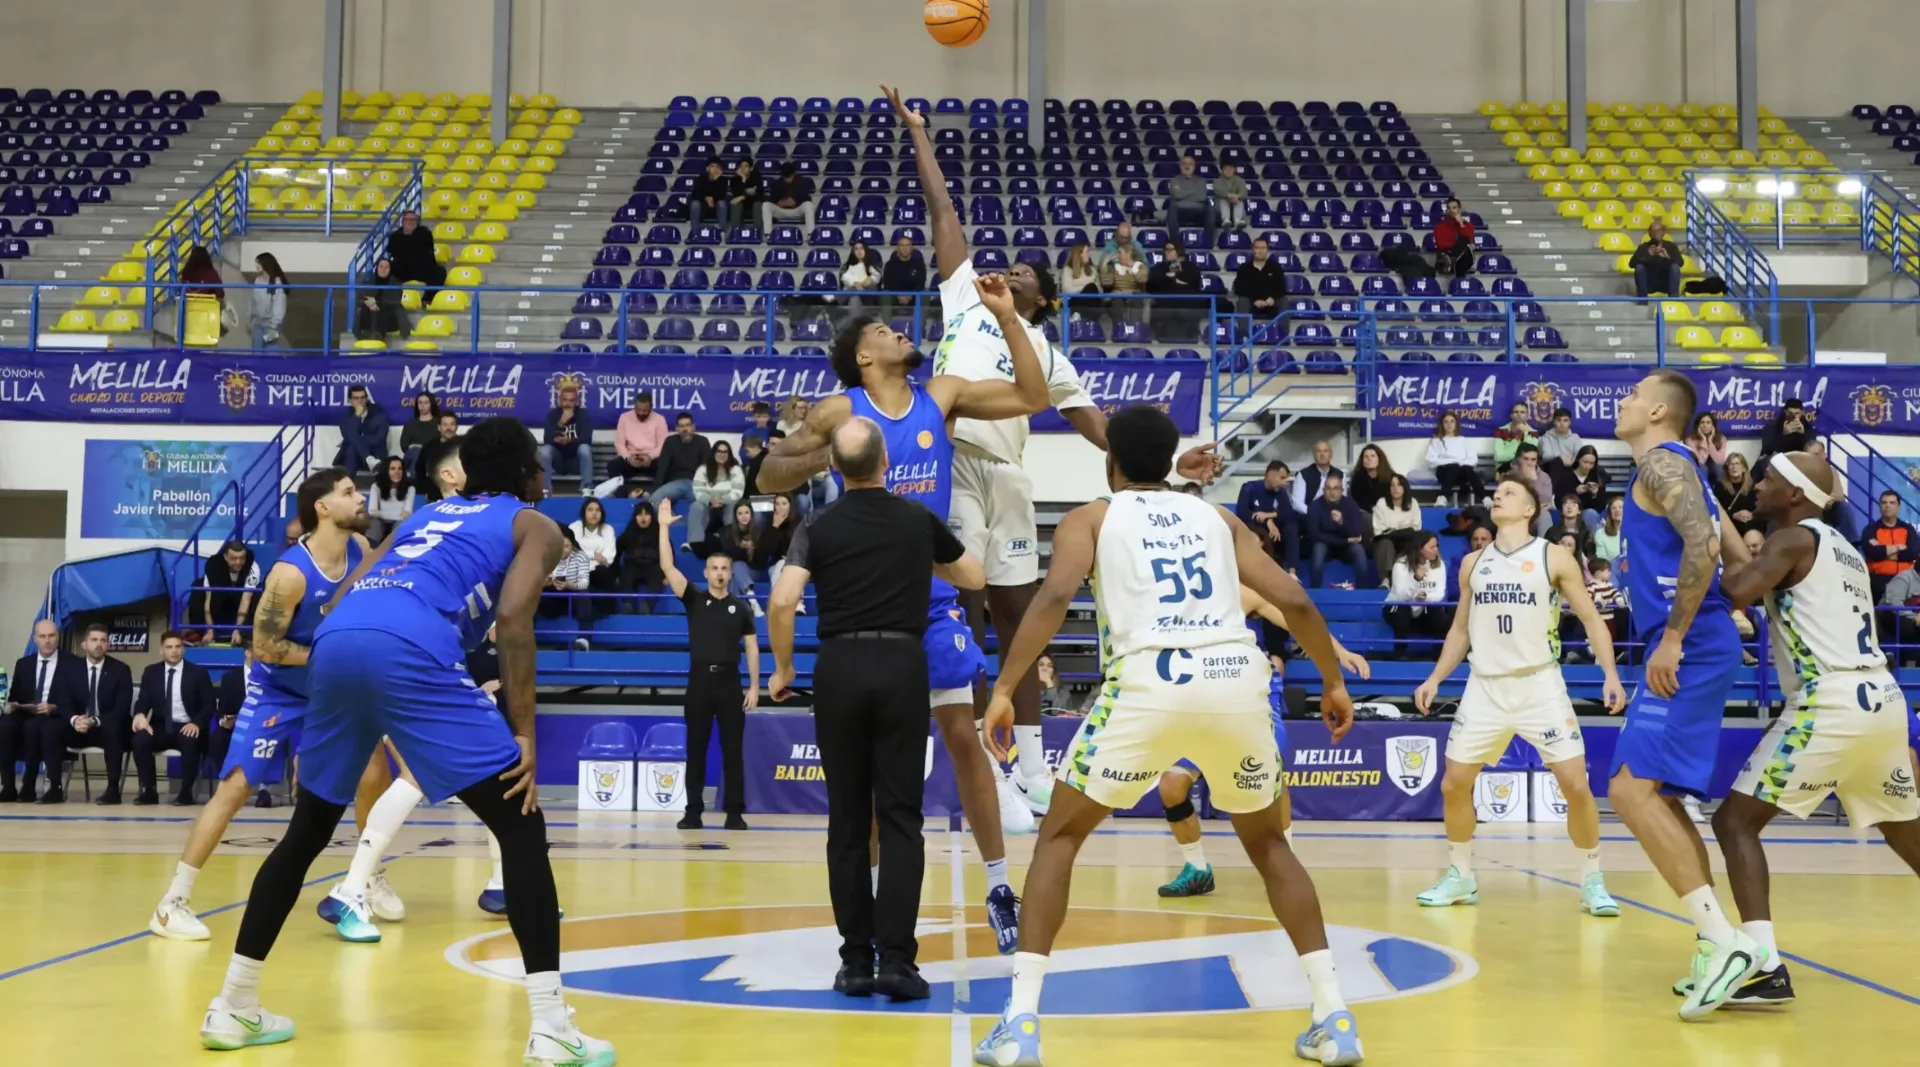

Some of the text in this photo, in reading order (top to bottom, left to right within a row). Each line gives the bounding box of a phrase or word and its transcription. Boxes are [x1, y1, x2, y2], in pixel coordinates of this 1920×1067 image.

[0, 367, 45, 378] ÓNOMA
[69, 358, 191, 390] MELILLA
[265, 372, 376, 384] CIUDAD AUTÓNOMA
[401, 364, 523, 395] MELILLA
[596, 375, 706, 386] CIUDAD AUTÓNOMA
[1378, 374, 1496, 407] MELILLA
[1571, 386, 1612, 396] CIUDAD
[70, 392, 185, 404] CIUDAD DEL DEPORTE
[446, 397, 465, 408] DEL
[469, 397, 515, 408] DEPORTE
[600, 387, 706, 410] MEILLA
[1380, 406, 1417, 417] CIUDAD
[167, 460, 228, 474] MELILLA
[153, 489, 211, 502] Pabellón
[114, 503, 154, 515] Javier
[1148, 512, 1182, 528] SOLA
[394, 520, 464, 559] 5
[1150, 551, 1213, 604] 55
[1486, 583, 1523, 591] HESTIA
[1474, 591, 1537, 606] MENORCA
[1496, 614, 1513, 634] 10
[1203, 654, 1250, 667] carreras
[1203, 666, 1242, 679] center
[1294, 749, 1364, 765] MELILLA
[1233, 771, 1269, 784] Esports
